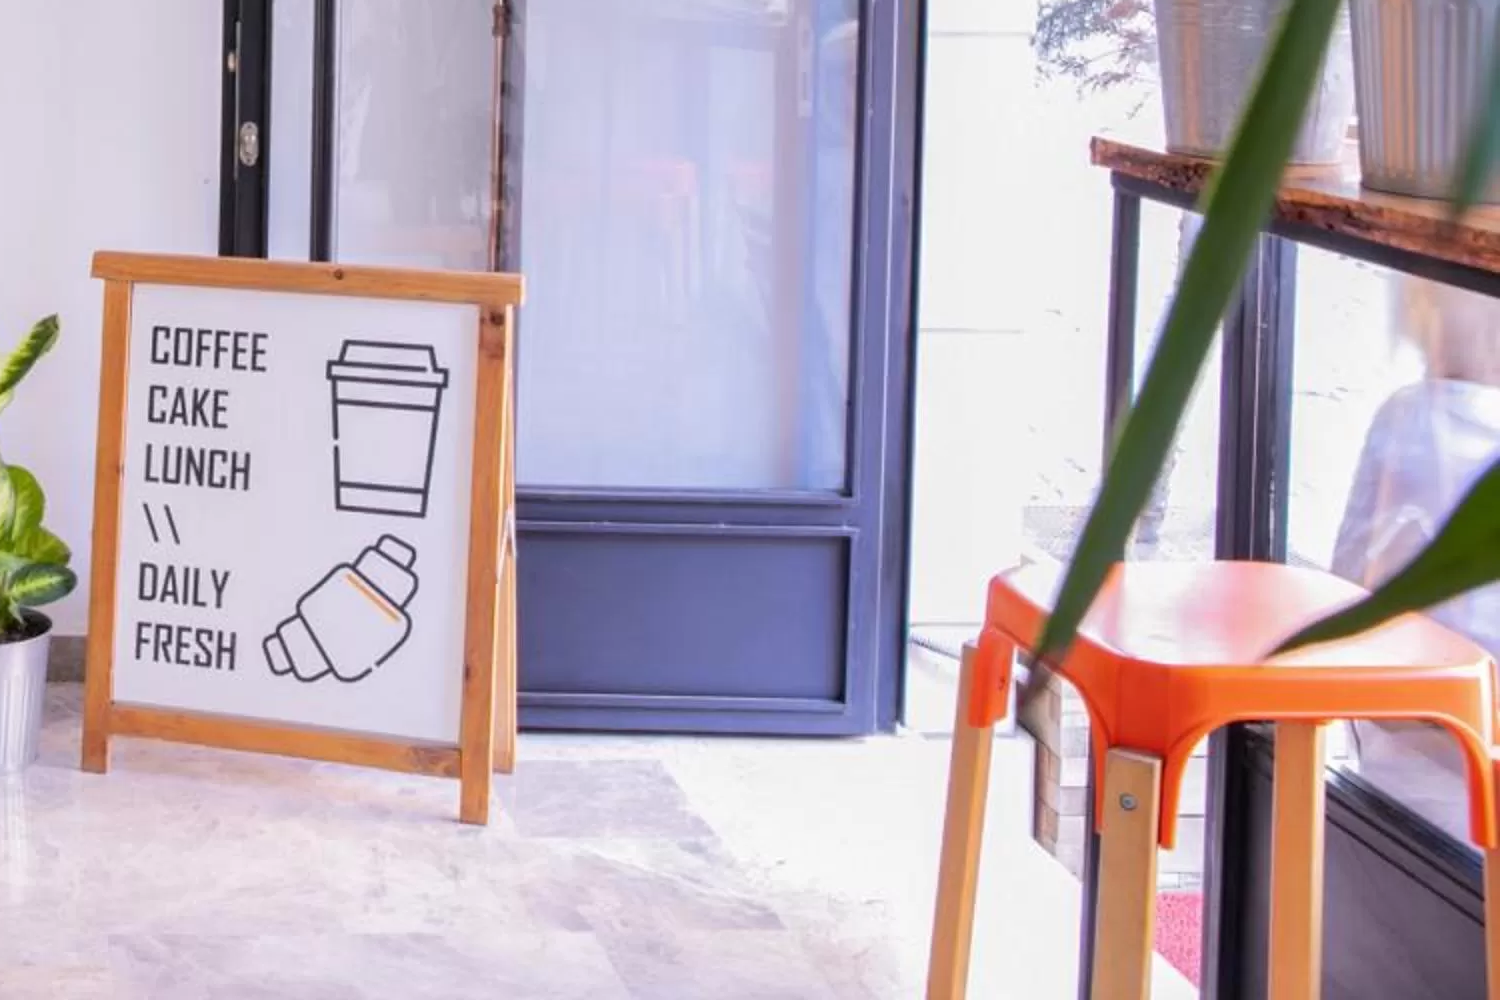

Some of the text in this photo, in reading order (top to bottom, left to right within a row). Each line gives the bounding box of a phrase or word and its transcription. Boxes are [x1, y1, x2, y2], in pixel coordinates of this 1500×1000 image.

[150, 325, 269, 373] COFFEE
[147, 384, 229, 429] CAKE
[144, 443, 251, 491] LUNCH
[138, 562, 230, 609] DAILY
[135, 621, 237, 671] FRESH
